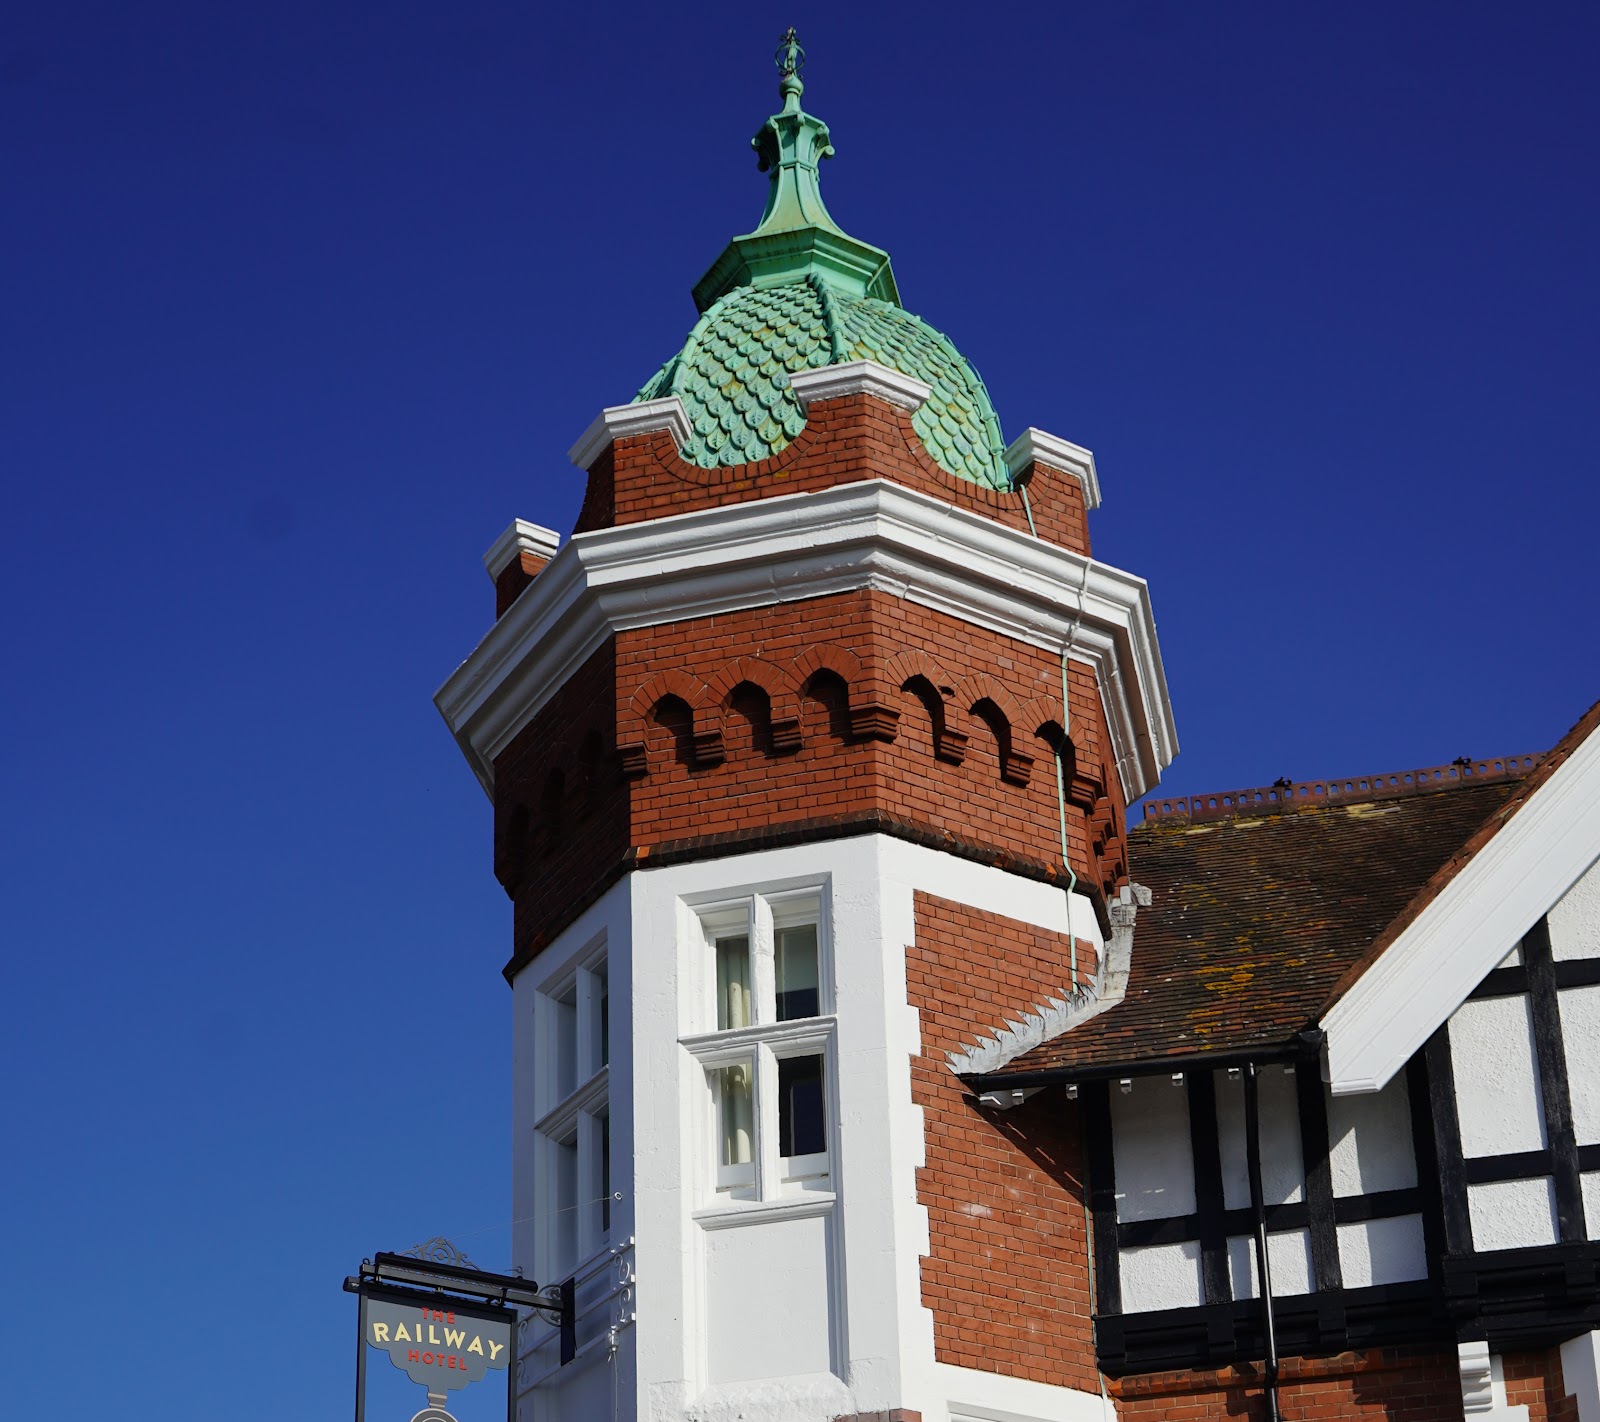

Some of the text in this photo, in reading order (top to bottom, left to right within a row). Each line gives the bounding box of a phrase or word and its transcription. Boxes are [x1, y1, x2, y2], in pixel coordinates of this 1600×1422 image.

[422, 1307, 456, 1325] THE
[373, 1322, 504, 1361] RAILWAY
[408, 1349, 467, 1371] HOTEL
